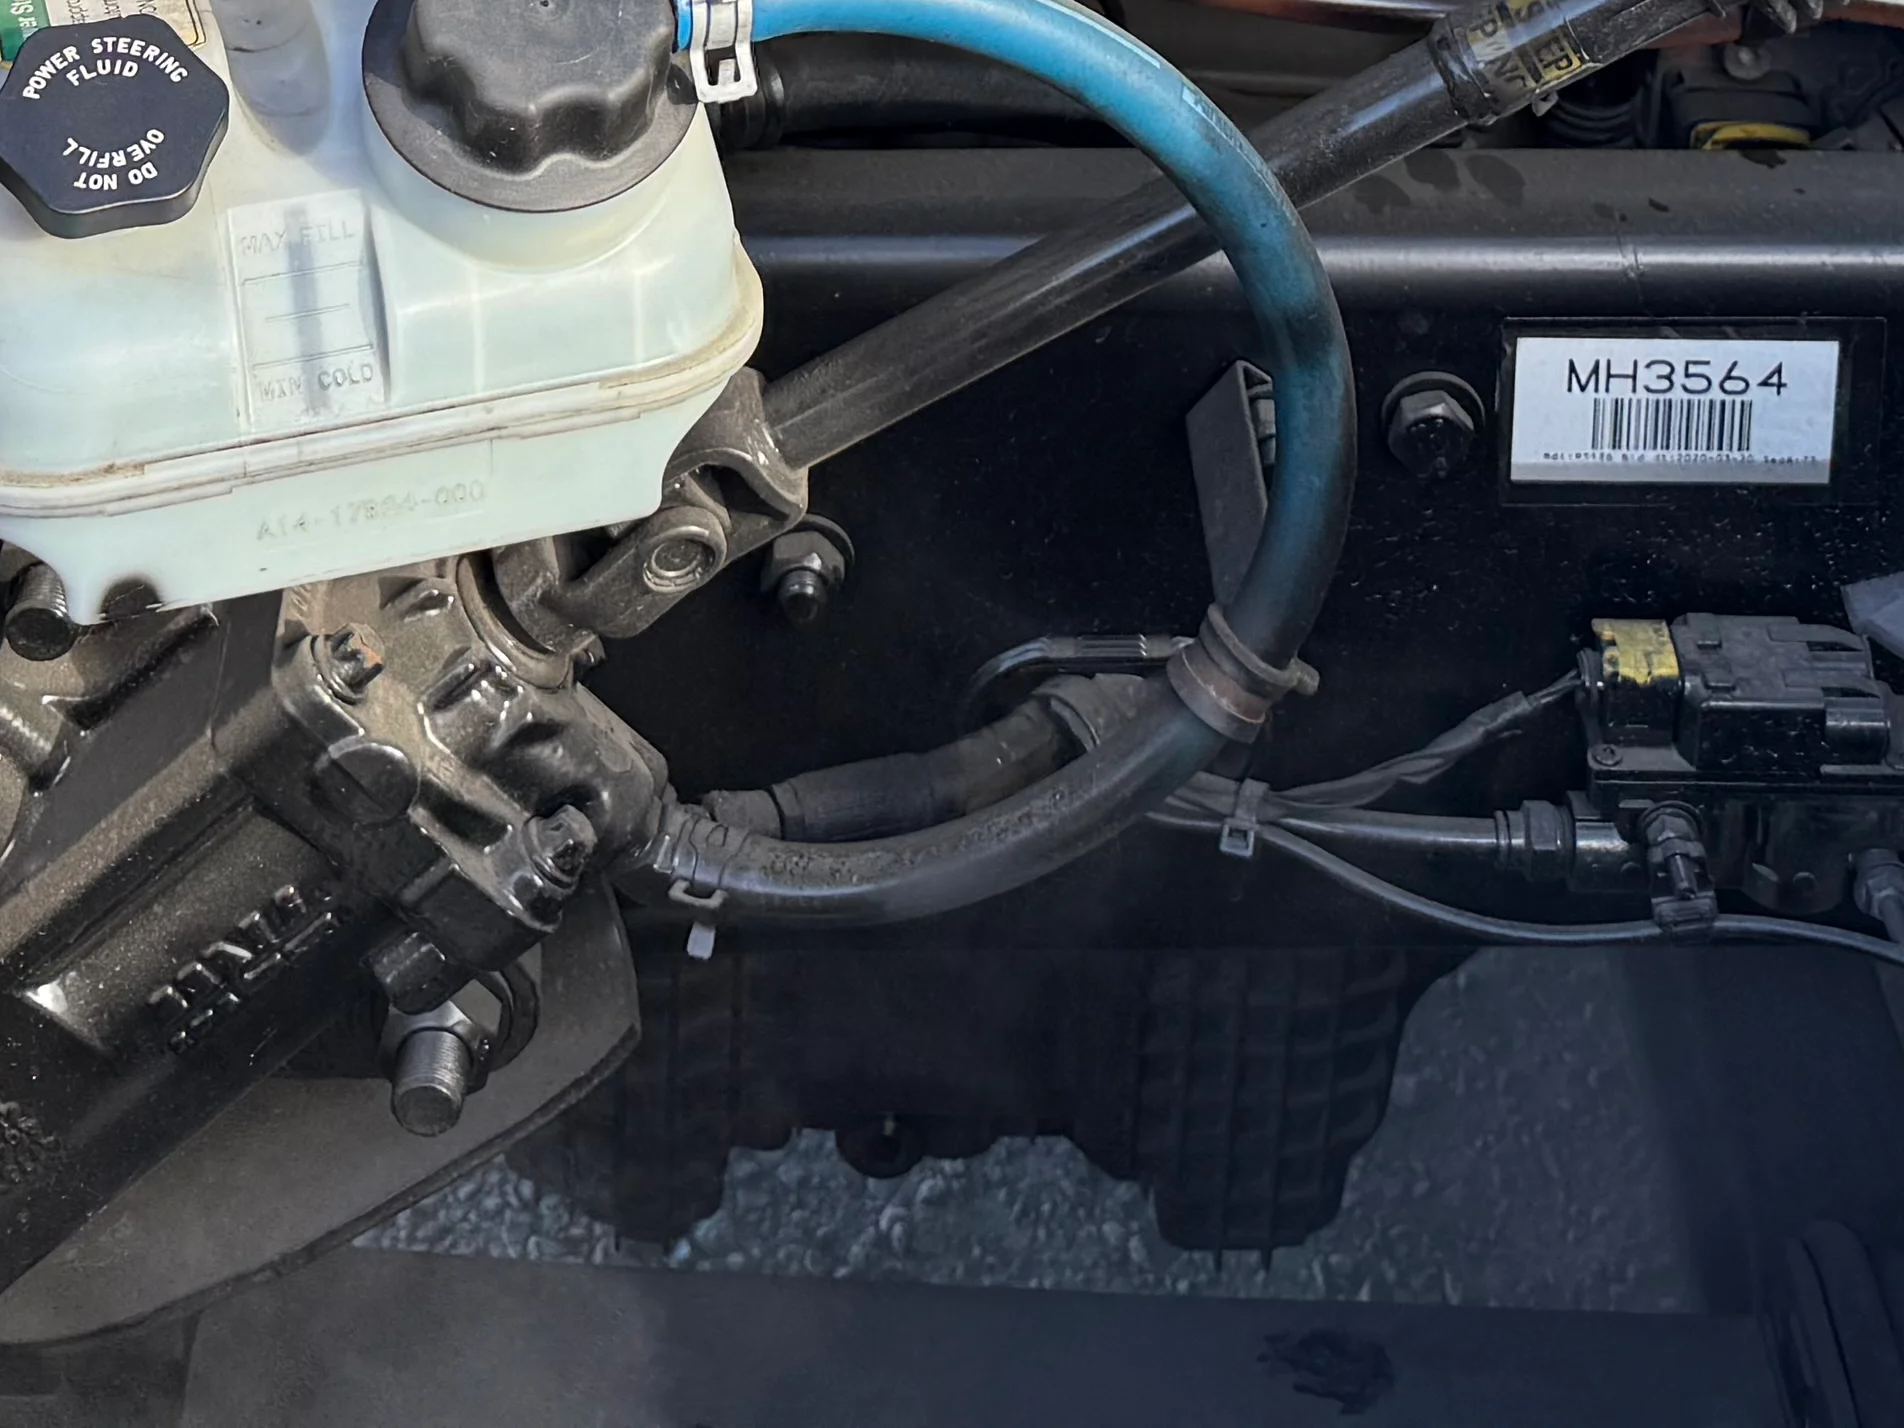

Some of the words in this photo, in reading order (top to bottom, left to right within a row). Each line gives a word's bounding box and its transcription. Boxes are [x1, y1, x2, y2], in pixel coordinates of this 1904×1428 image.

[22, 44, 81, 100] POWER
[90, 35, 189, 84] STEERING
[66, 58, 140, 87] FLUID
[60, 128, 165, 169] OVERFILL
[73, 171, 119, 191] NOT
[128, 161, 159, 186] DO
[241, 230, 288, 255] MAX
[300, 220, 355, 246] FILL
[317, 363, 374, 391] COLD
[1566, 358, 1788, 396] MH3564
